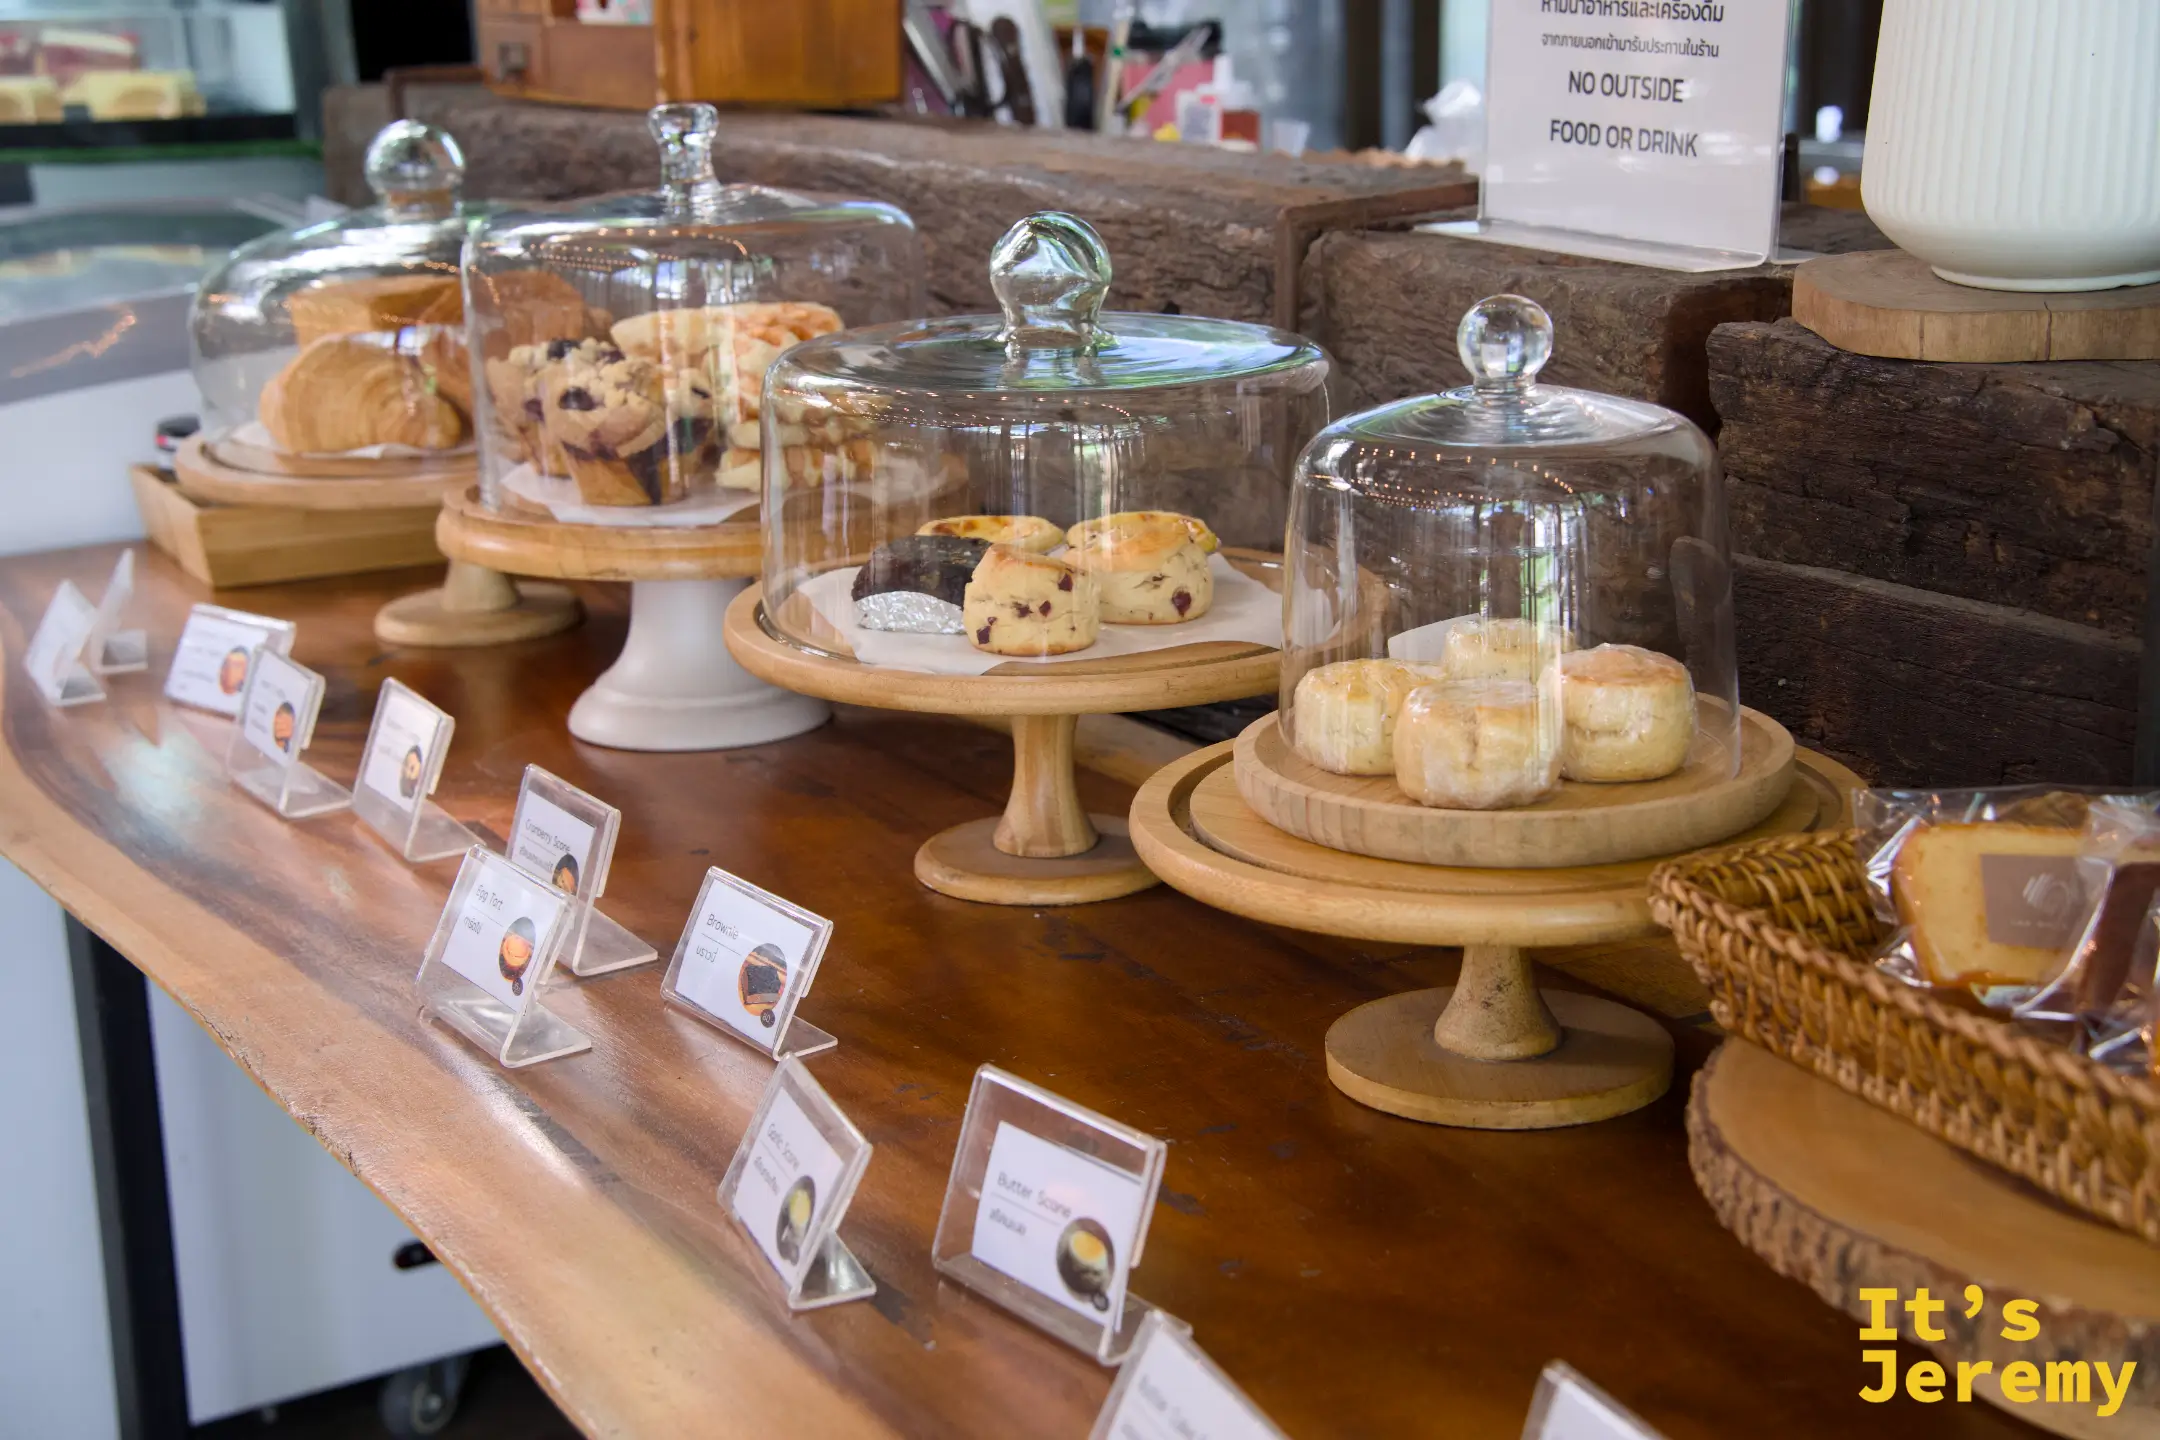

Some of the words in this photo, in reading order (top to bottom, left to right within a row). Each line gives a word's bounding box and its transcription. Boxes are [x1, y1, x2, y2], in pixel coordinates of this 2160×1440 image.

[1541, 33, 1720, 58] จากภายนอกเข้ามารับประทานในร้าน
[1568, 71, 1596, 95] NO
[1601, 73, 1685, 103] OUTSIDE
[1550, 119, 1601, 146] FOOD
[1606, 125, 1633, 150] OR
[1638, 128, 1699, 157] DRINK
[553, 835, 571, 852] Scone
[476, 884, 489, 903] Egg
[489, 892, 504, 911] Tart
[706, 913, 739, 940] Brownie
[997, 1171, 1033, 1199] Butter
[1037, 1190, 1072, 1218] Scone
